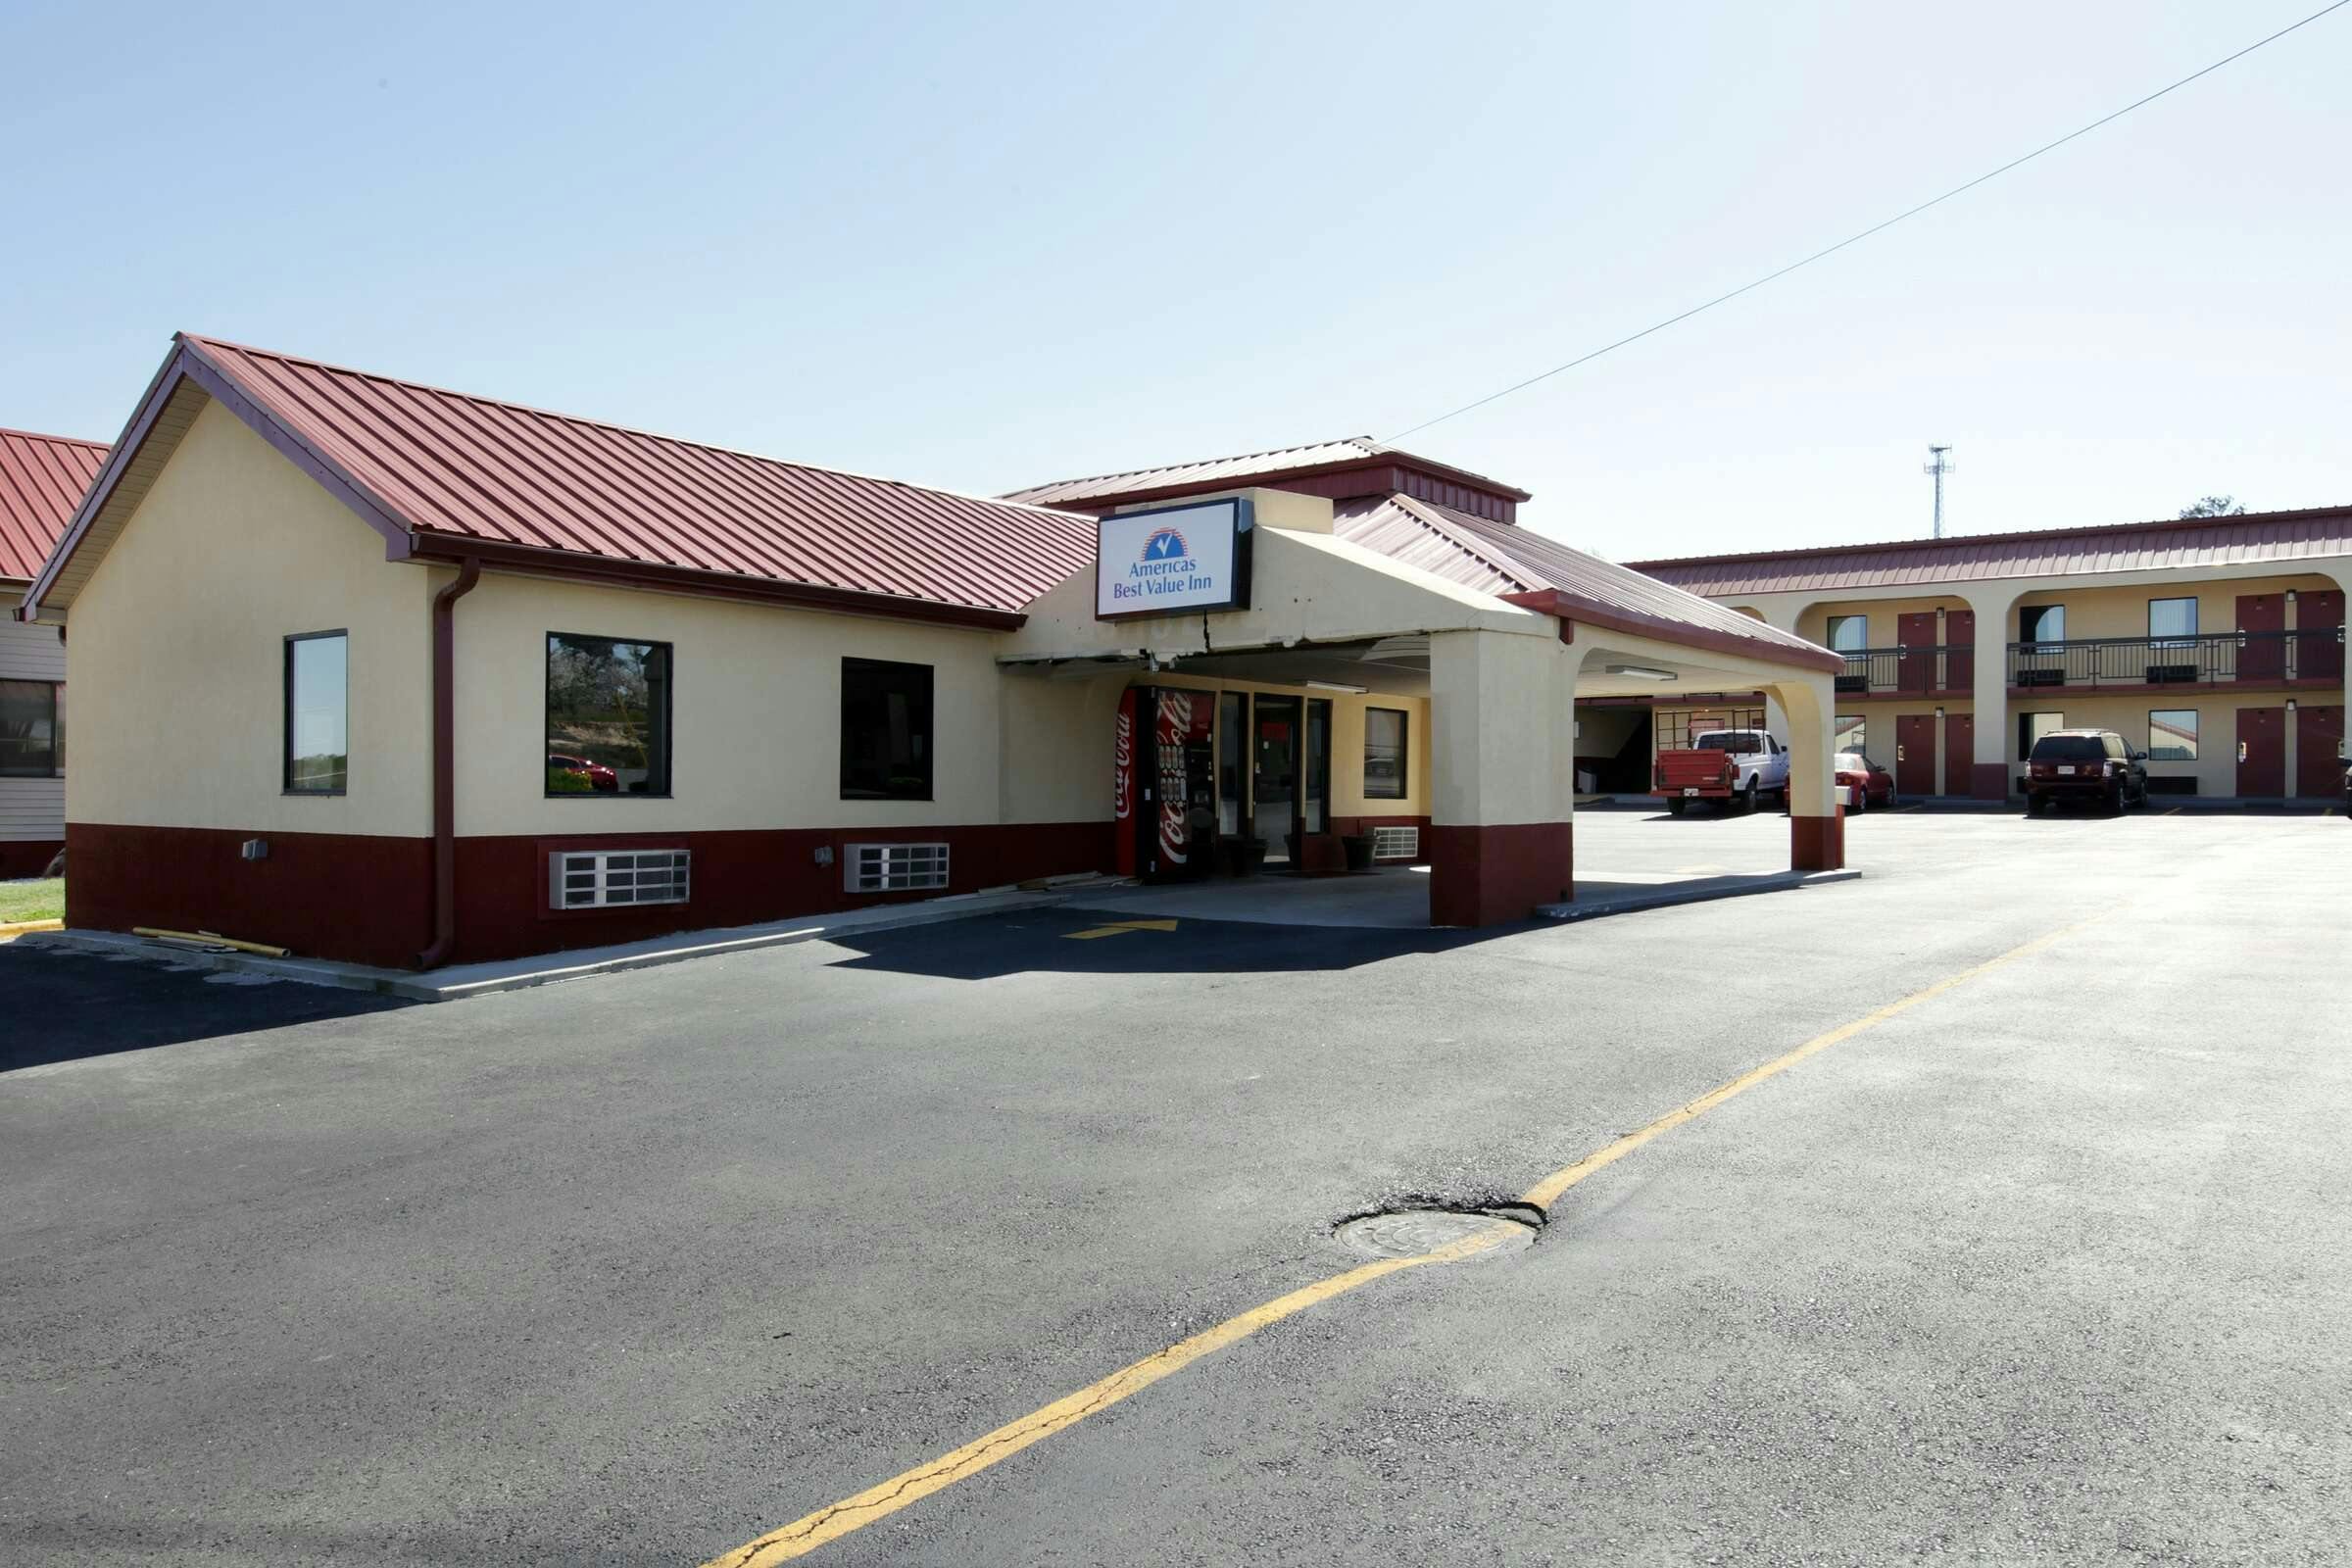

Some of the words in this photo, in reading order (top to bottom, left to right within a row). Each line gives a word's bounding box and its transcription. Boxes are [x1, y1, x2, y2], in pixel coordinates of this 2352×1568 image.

[1129, 558, 1197, 578] Americas
[1113, 581, 1143, 599] Best
[1146, 577, 1185, 596] Value
[1189, 574, 1212, 591] Inn
